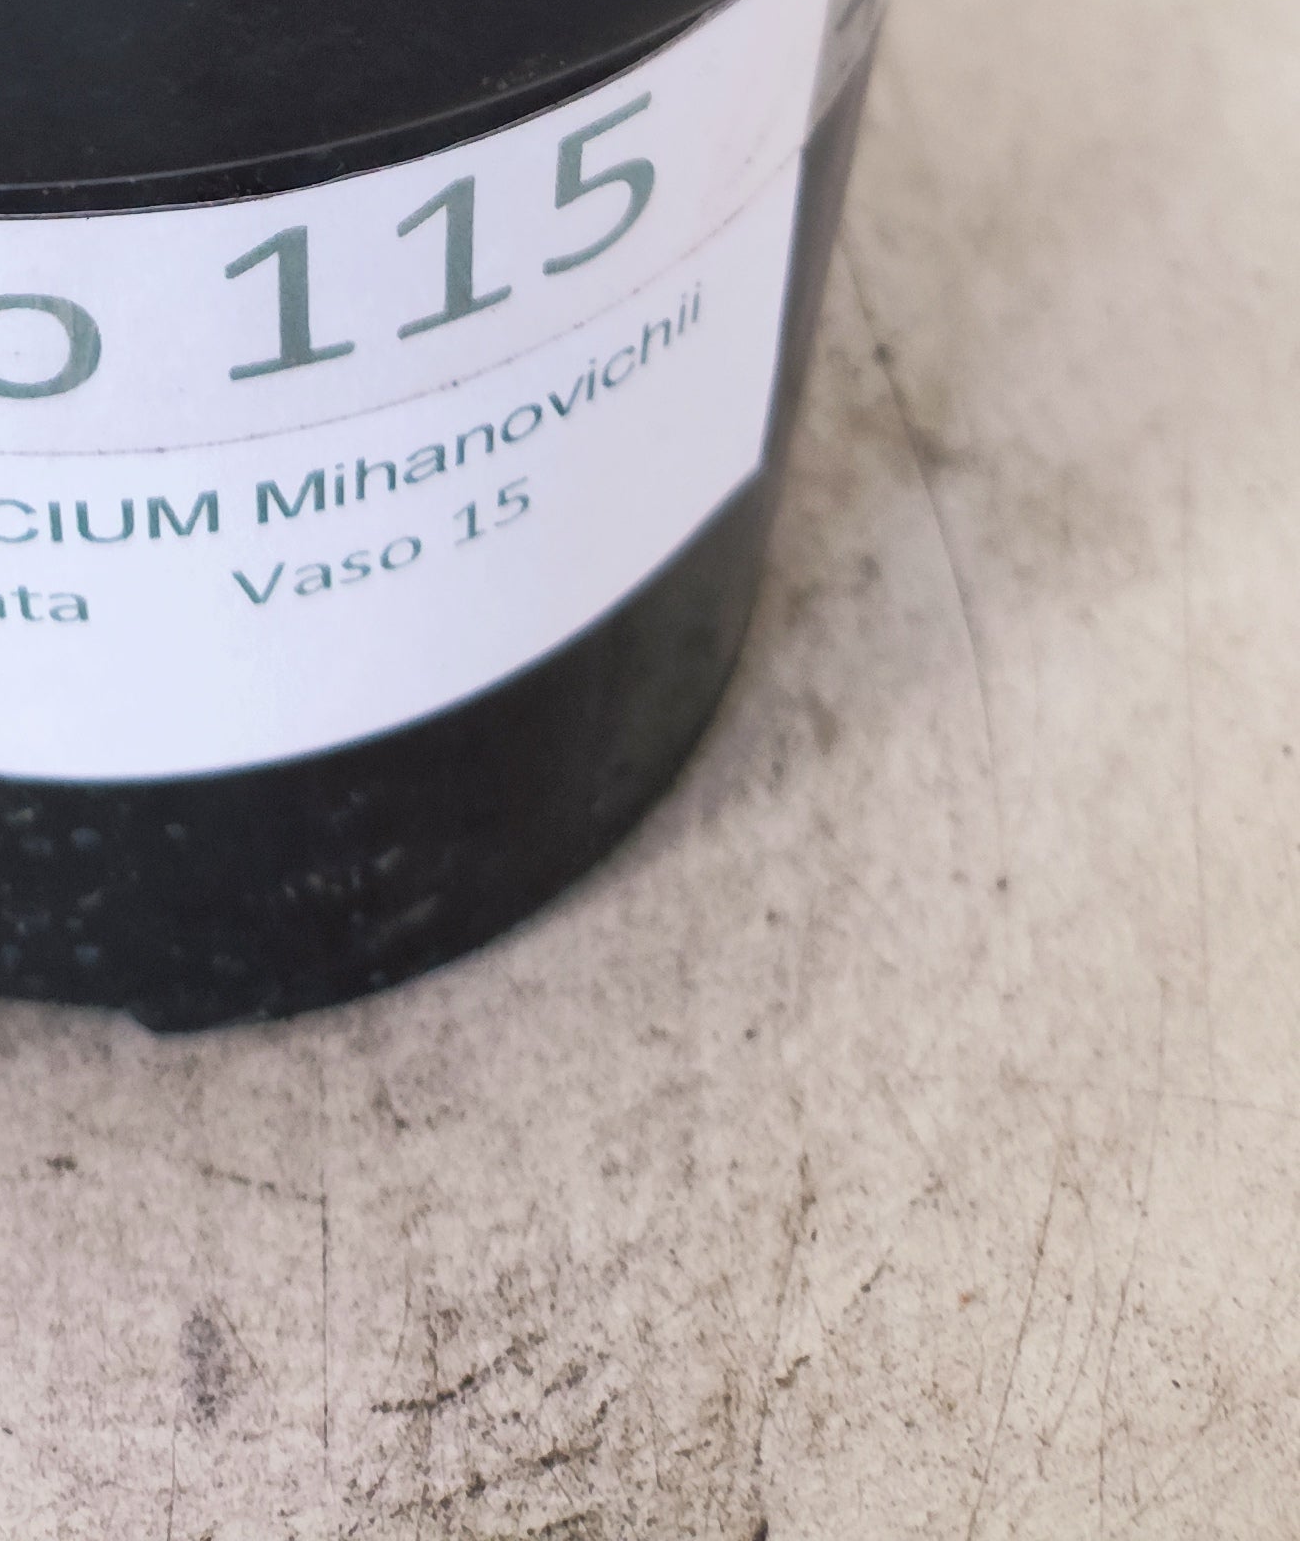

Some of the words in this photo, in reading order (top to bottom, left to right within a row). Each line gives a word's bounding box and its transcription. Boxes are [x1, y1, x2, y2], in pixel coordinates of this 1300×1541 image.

[222, 91, 658, 383] 115
[253, 279, 703, 526] Mihanovichii
[230, 532, 423, 608] Vaso
[451, 476, 533, 547] 15
